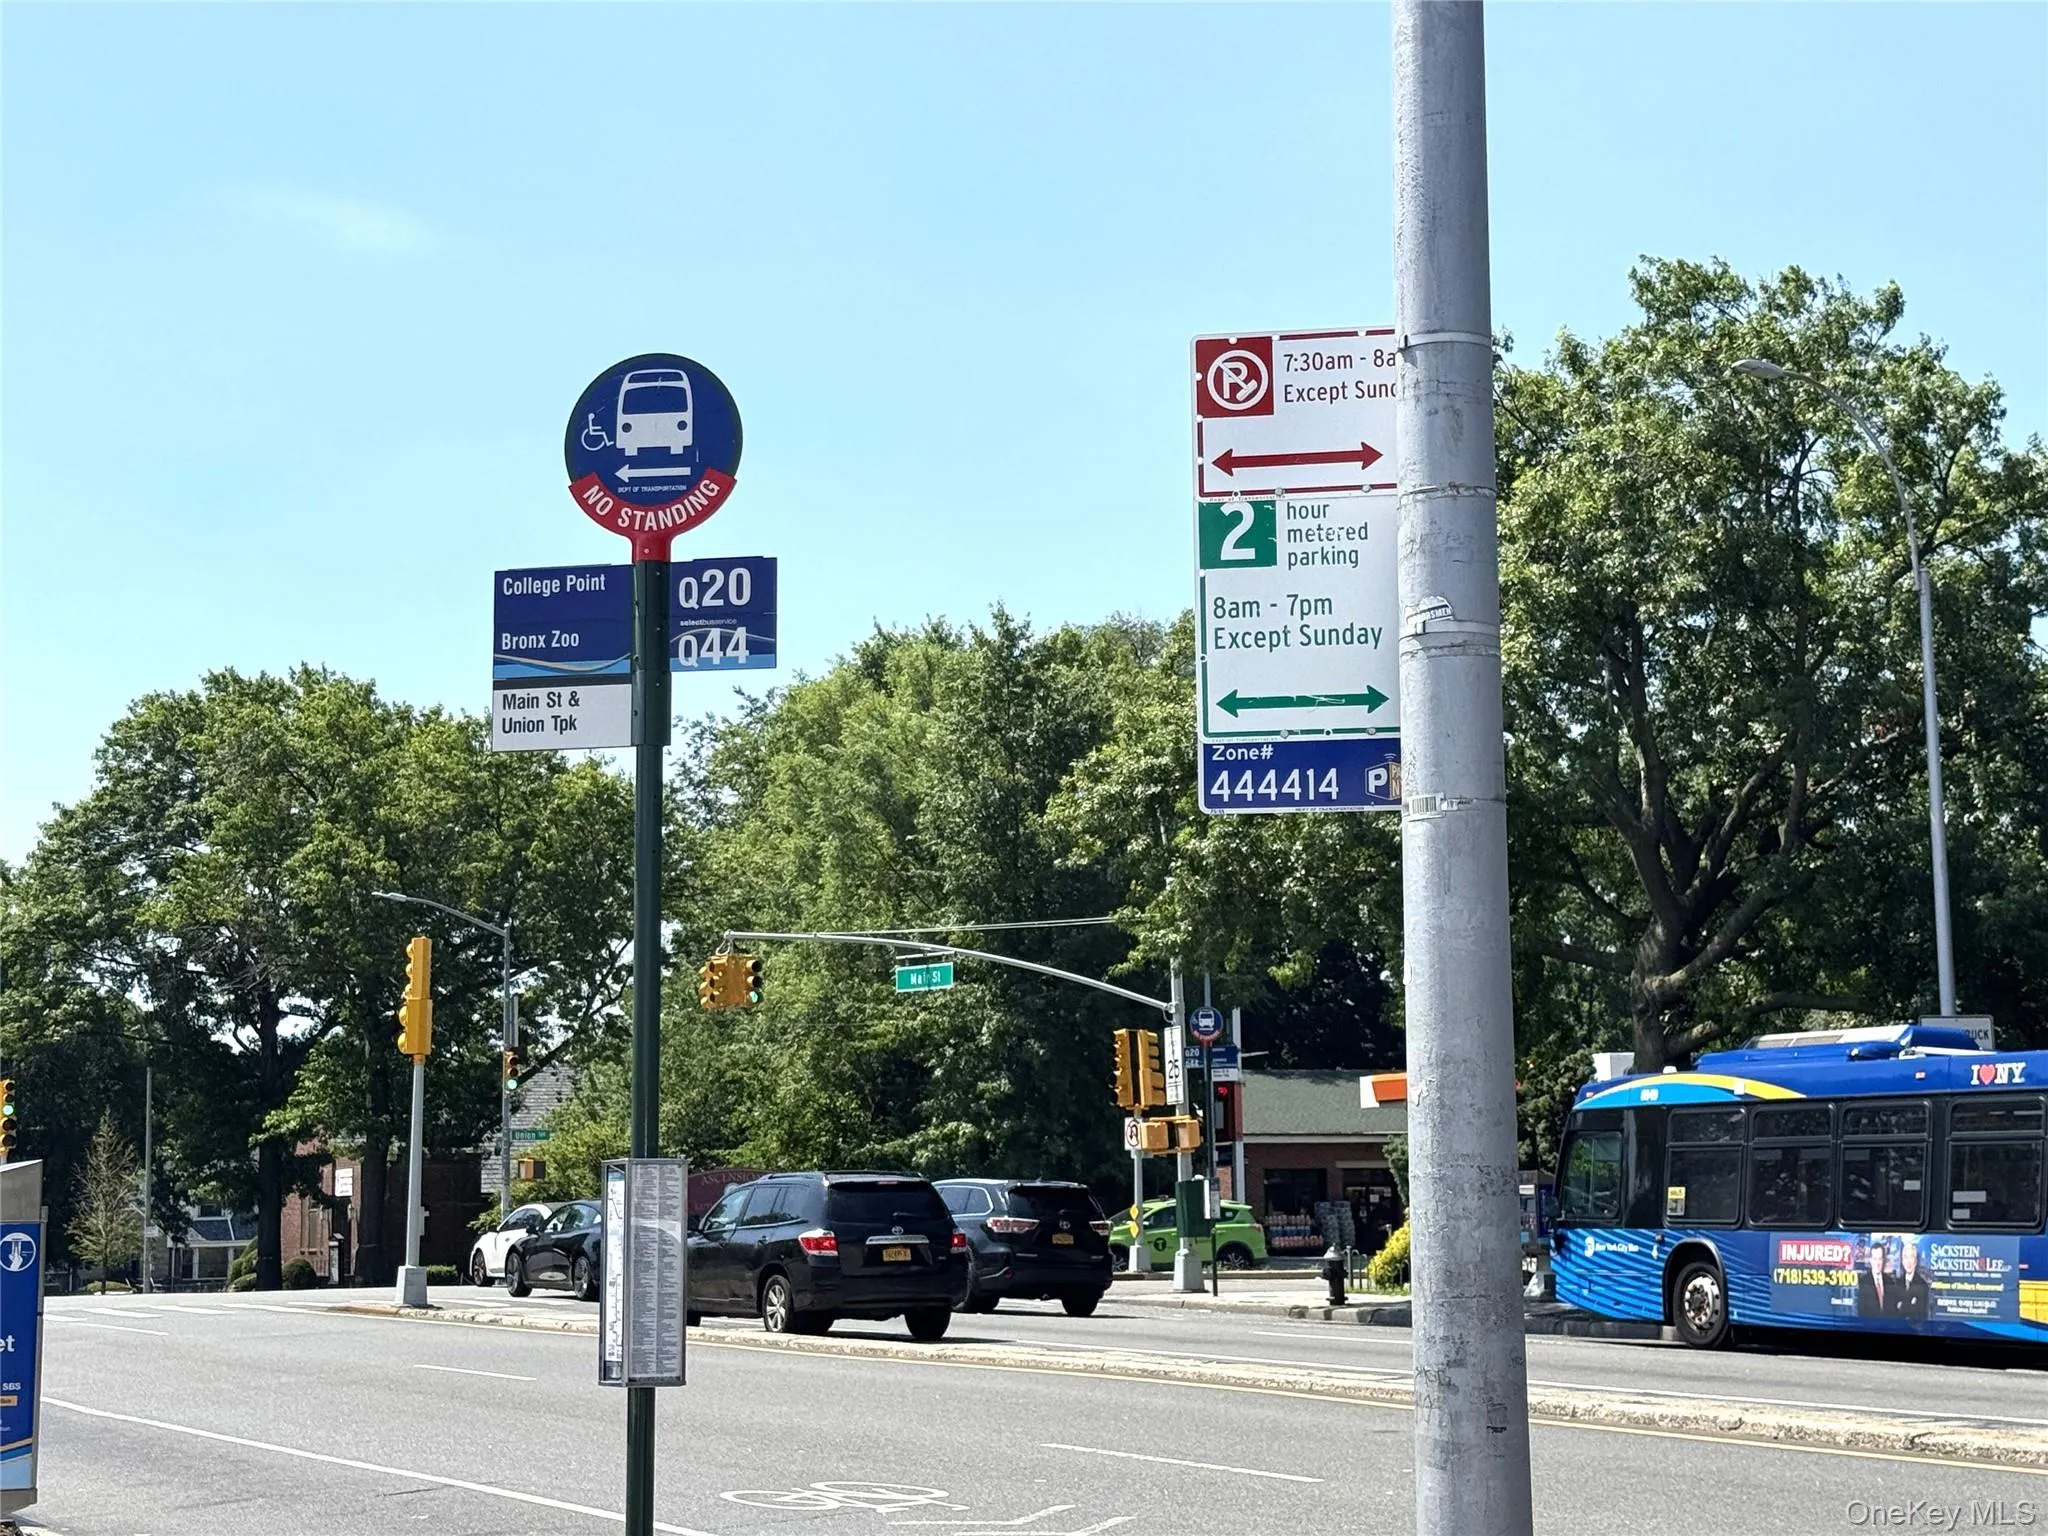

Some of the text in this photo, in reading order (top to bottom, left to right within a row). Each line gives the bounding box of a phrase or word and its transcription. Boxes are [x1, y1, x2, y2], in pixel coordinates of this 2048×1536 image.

[1283, 352, 1353, 372] 7:30am
[1284, 381, 1348, 404] Except
[582, 479, 720, 531] NO STANDING
[1287, 502, 1330, 519] hour
[1220, 501, 1256, 560] 2
[1287, 522, 1368, 543] metered
[1287, 546, 1359, 570] parking
[503, 574, 606, 597] College Point
[678, 567, 751, 609] Q20
[1213, 597, 1261, 619] 8am
[1287, 594, 1333, 621] 7pm
[502, 631, 580, 650] Bronx Zoo
[678, 626, 750, 668] Q44
[1214, 622, 1382, 652] Except Sunday
[502, 690, 580, 710] Main St &
[502, 715, 577, 734] Union Tpk
[1212, 744, 1274, 761] Zone#
[1210, 768, 1340, 802] 444414
[1168, 1059, 1180, 1079] 25
[1781, 1243, 1852, 1262] INJURED?
